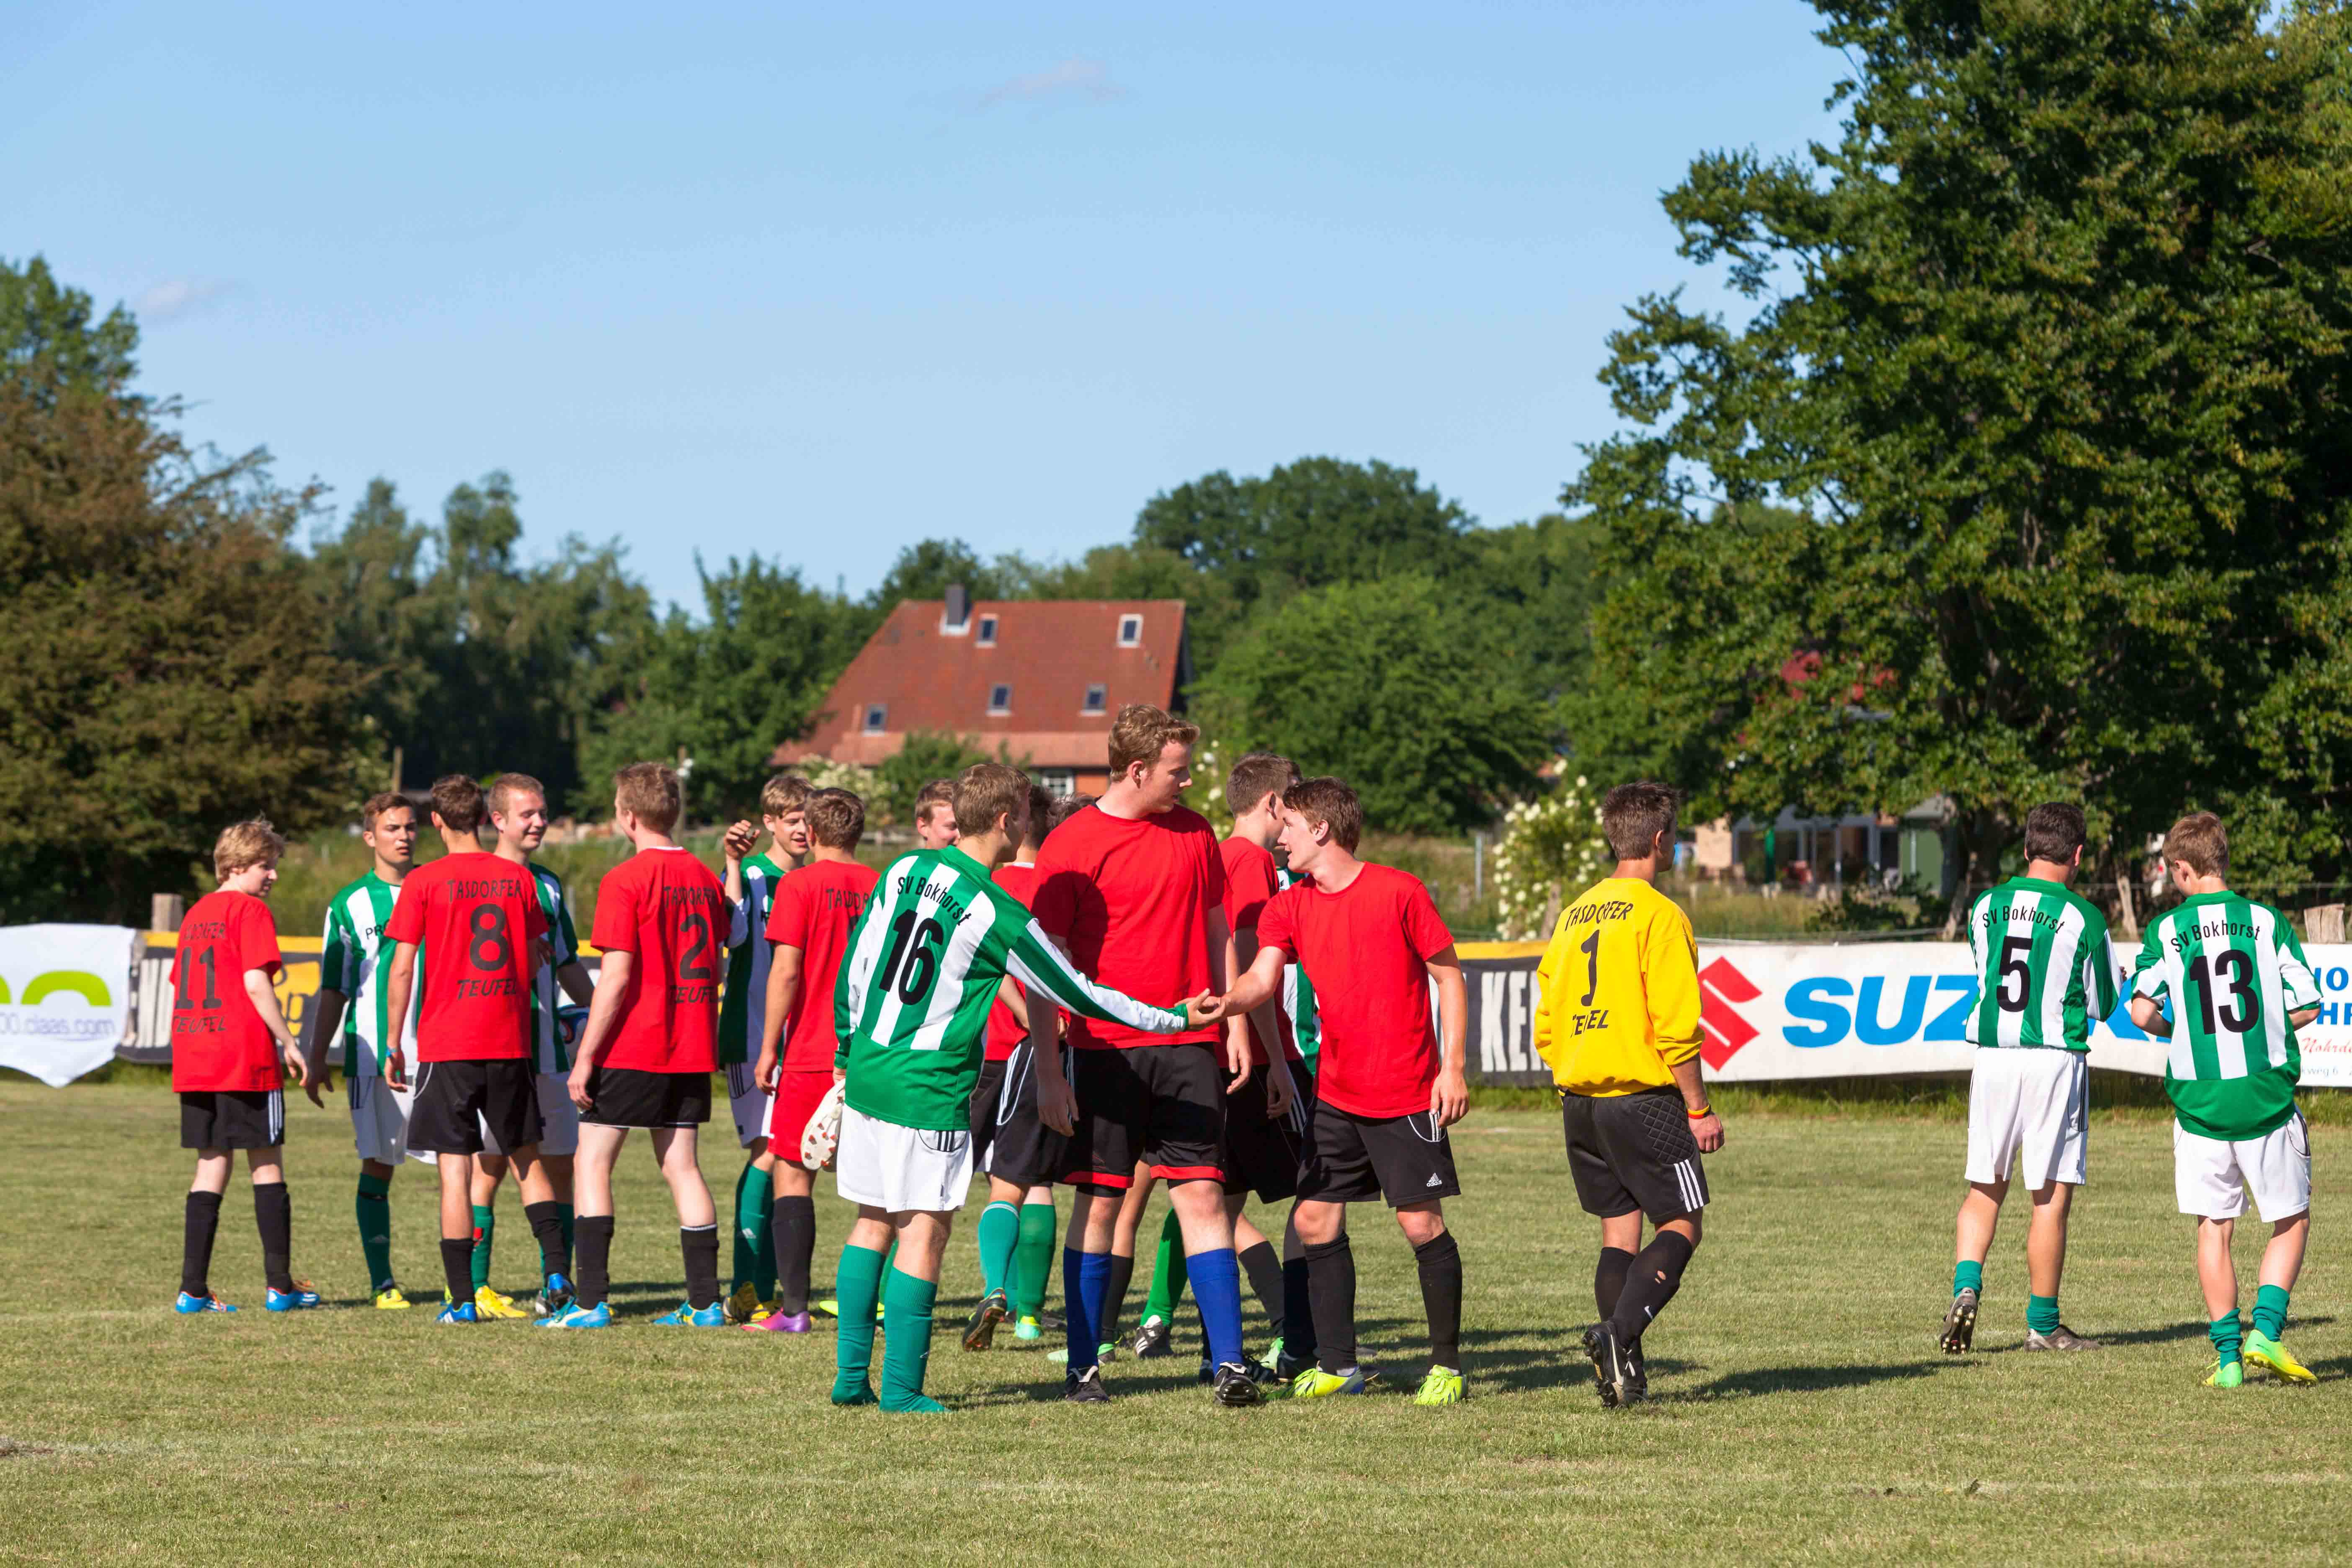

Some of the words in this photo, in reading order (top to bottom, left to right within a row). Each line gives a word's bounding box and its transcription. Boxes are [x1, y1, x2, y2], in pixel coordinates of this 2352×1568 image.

[447, 879, 522, 902] TASDORFER
[897, 876, 915, 895] SV
[915, 877, 972, 926] Bokhorst
[1982, 908, 1997, 928] SV
[2002, 905, 2065, 934] Bokhorst
[469, 903, 510, 971] 8
[680, 913, 711, 980] 2
[879, 908, 944, 1006] 16
[1581, 929, 1600, 1007] 1
[2171, 931, 2190, 953] SV
[2191, 919, 2260, 941] Bokhorst
[175, 944, 222, 1010] 11
[457, 978, 517, 1000] TEUFEL
[1996, 935, 2034, 1013] 5
[2189, 949, 2259, 1035] 13
[172, 1015, 227, 1033] TEUFEL
